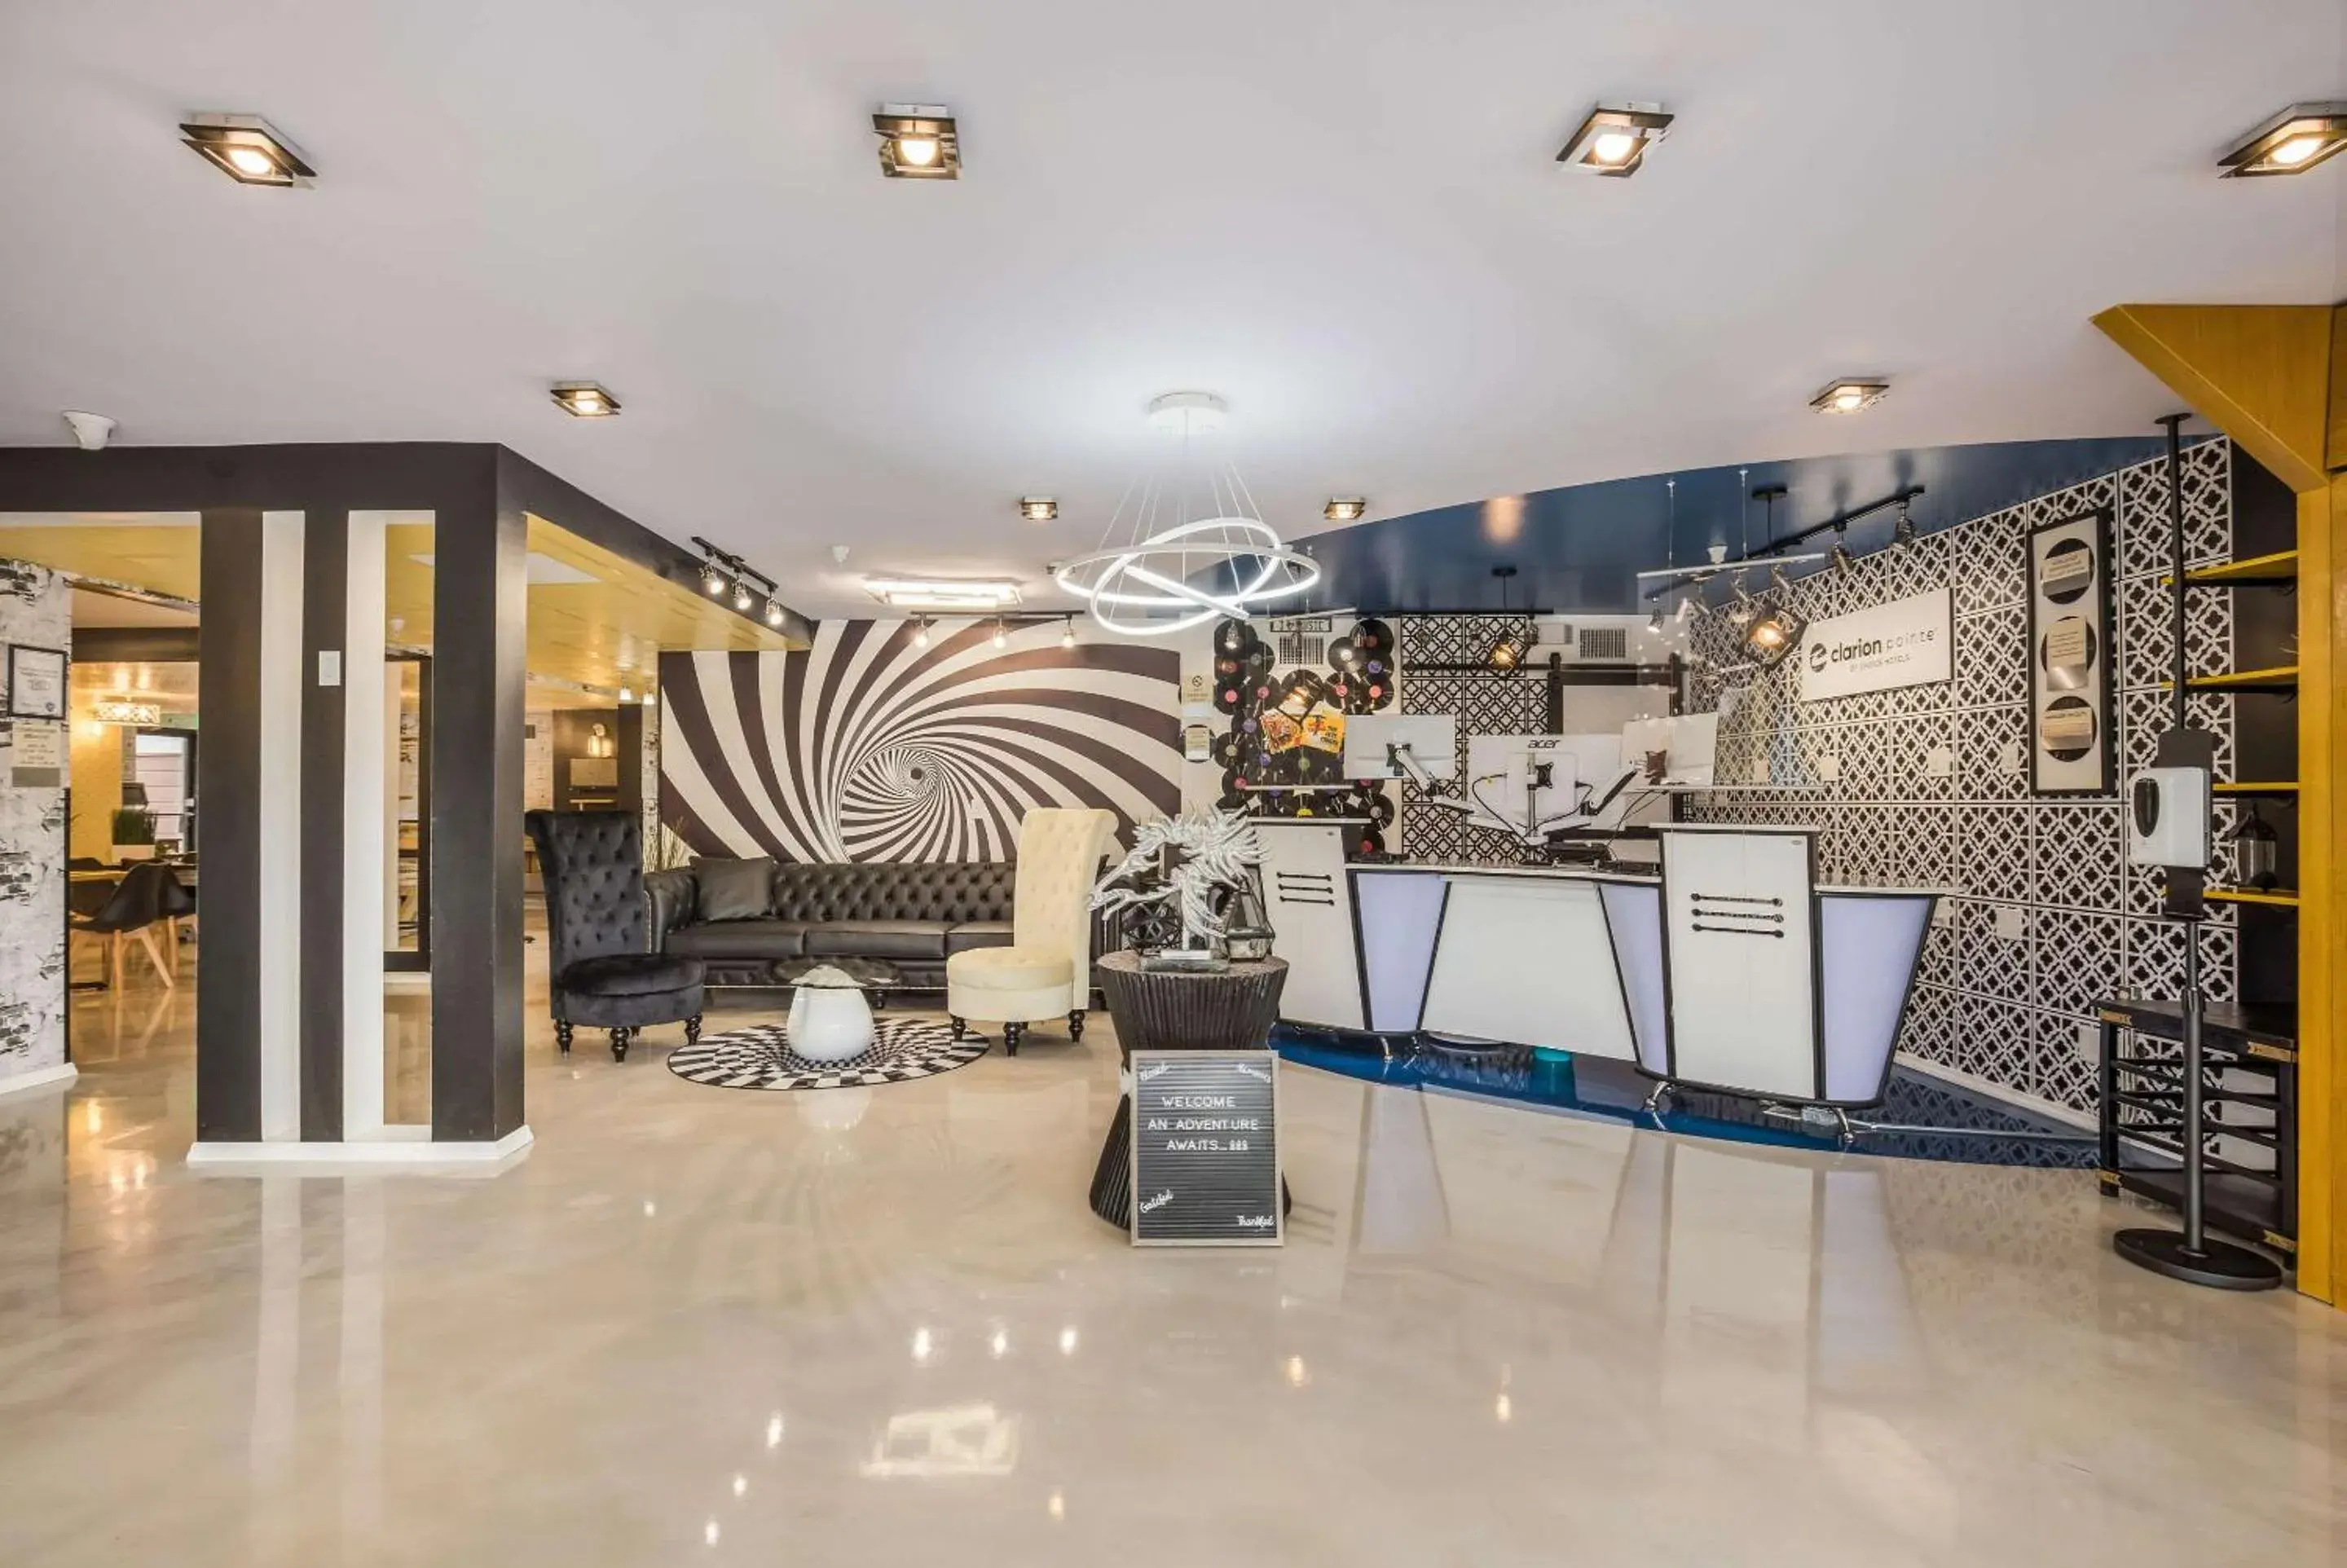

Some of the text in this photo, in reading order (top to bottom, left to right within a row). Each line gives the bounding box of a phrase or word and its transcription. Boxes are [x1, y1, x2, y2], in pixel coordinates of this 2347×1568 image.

[1830, 638, 1882, 663] clarion
[1528, 739, 1561, 748] acer
[1161, 1096, 1236, 1108] WELCOME
[1147, 1119, 1259, 1130] AN ADVENTURE
